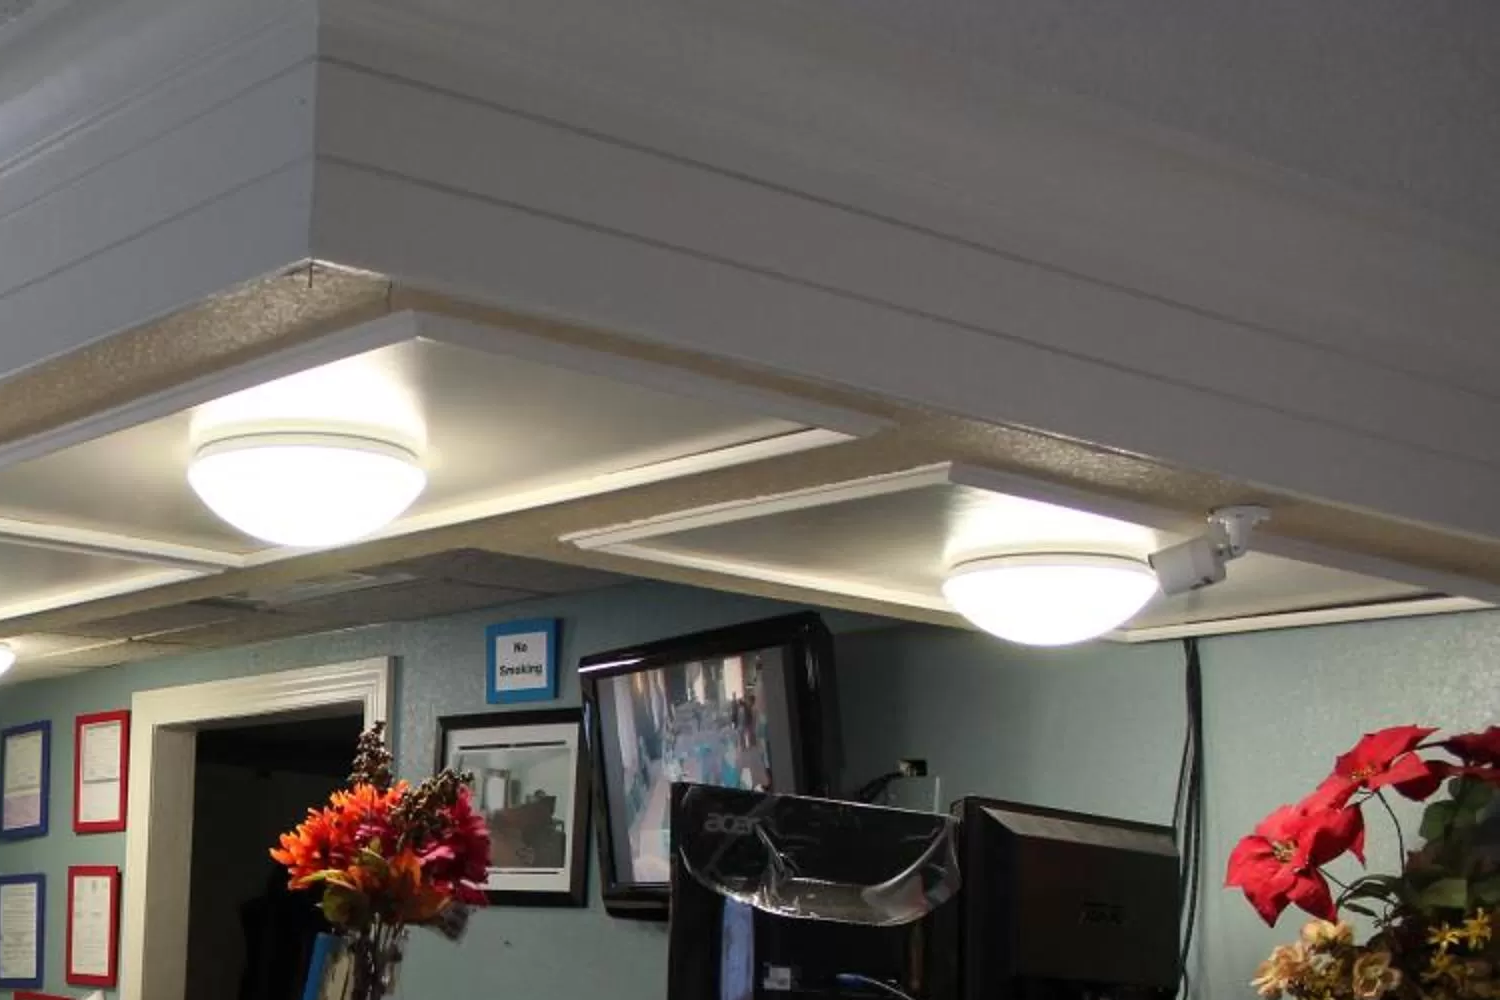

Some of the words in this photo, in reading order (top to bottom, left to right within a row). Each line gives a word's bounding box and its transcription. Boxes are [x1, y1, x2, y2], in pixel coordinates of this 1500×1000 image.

[513, 642, 528, 653] No
[500, 664, 543, 676] Smoking
[704, 812, 762, 835] acer
